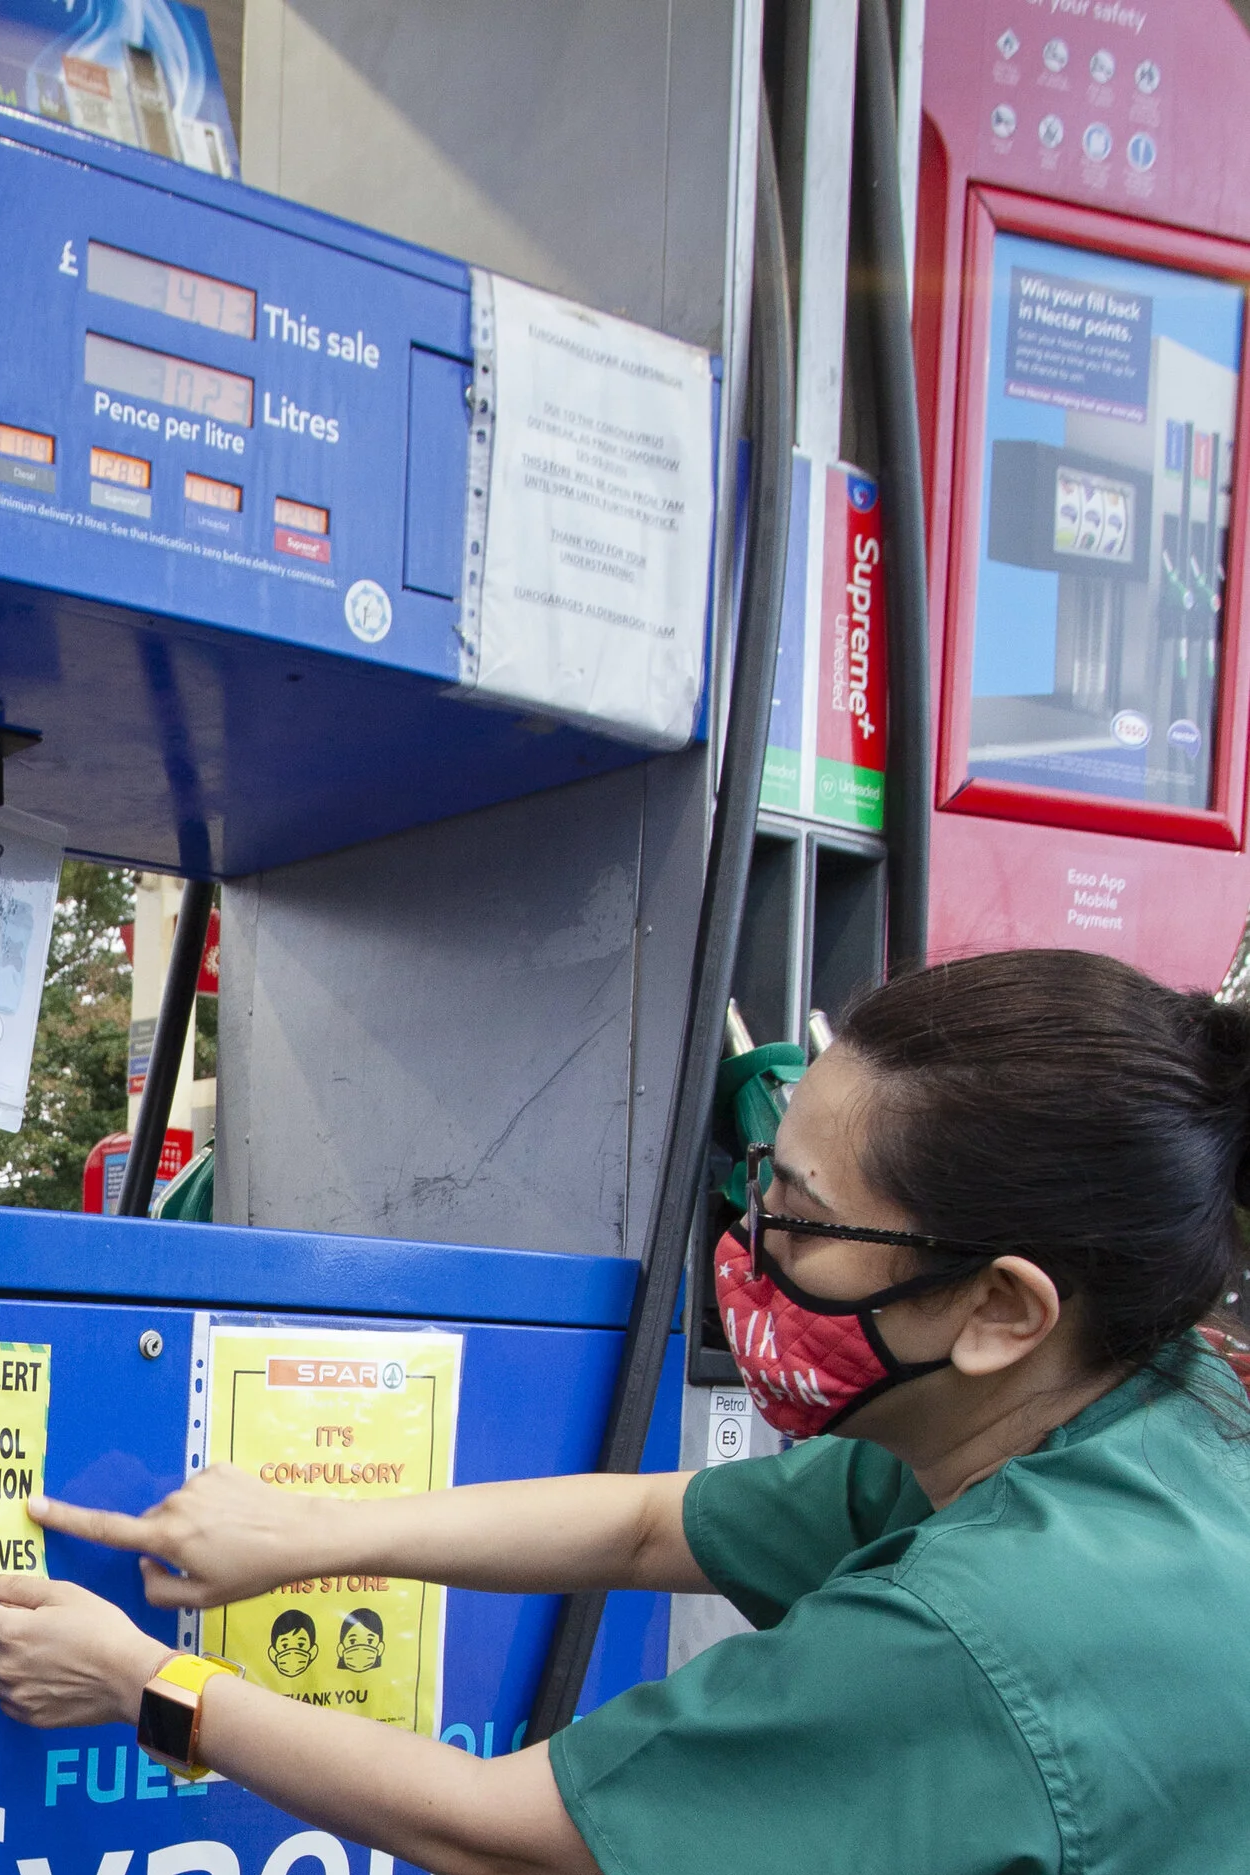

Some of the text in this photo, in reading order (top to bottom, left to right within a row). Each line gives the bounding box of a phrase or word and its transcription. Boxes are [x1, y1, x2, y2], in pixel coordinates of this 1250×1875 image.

[1094, 1, 1147, 35] safety
[58, 239, 79, 278] £
[1020, 275, 1142, 322] Win your fill back
[1018, 299, 1133, 343] in Nectar points.
[263, 303, 380, 369] This sale
[94, 390, 246, 455] Pence per litre
[263, 392, 340, 444] Litres
[38, 503, 75, 526] delivery
[76, 513, 83, 525] 2
[84, 515, 109, 532] litres.
[111, 522, 128, 538] See
[130, 526, 148, 542] that
[149, 528, 192, 553] indication
[194, 541, 201, 553] is
[202, 545, 222, 561] zero
[223, 548, 251, 568] before
[253, 555, 287, 578] delivery
[846, 533, 879, 740] Supreme+
[831, 613, 849, 712] Unleaded
[1118, 719, 1145, 738] Esso
[839, 779, 881, 801] Unleaded
[1067, 867, 1126, 894] Esso App
[1073, 889, 1118, 911] Mobile
[1067, 908, 1124, 931] Payment
[297, 1364, 378, 1384] SPAR
[716, 1395, 747, 1412] Petrol
[315, 1425, 355, 1447] IT'S
[722, 1429, 737, 1446] E5
[259, 1462, 406, 1484] COMPULSORY
[320, 1575, 391, 1593] STORE
[335, 1689, 369, 1705] YOU
[45, 1745, 208, 1807] FUE
